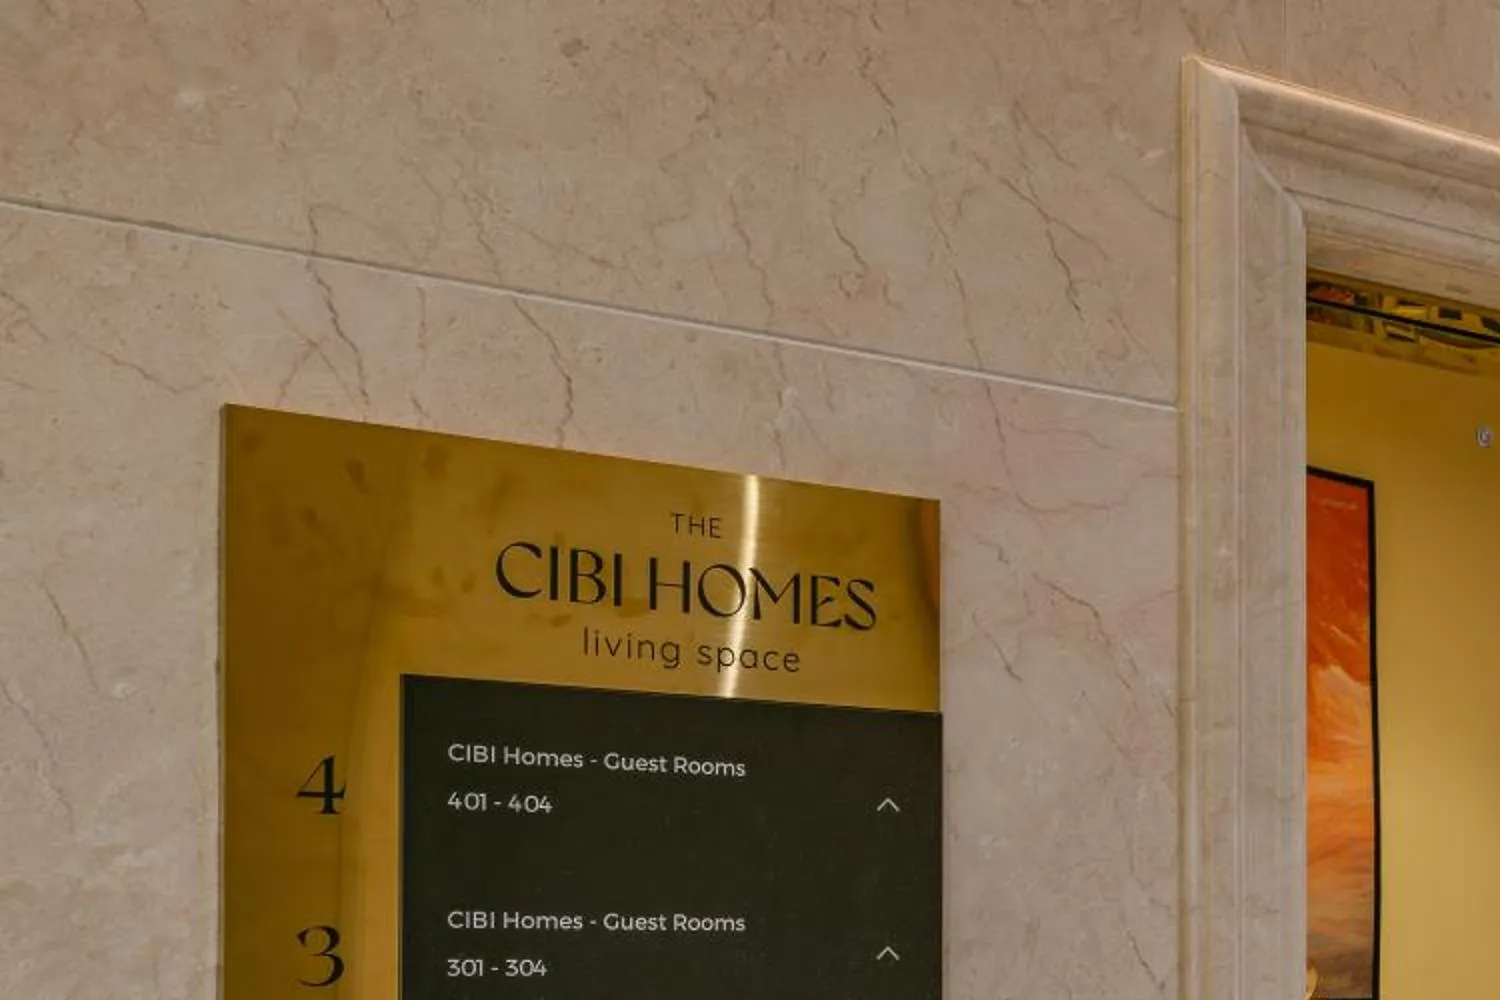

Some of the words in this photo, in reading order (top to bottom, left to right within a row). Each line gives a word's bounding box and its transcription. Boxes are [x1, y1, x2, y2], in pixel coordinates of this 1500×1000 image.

[670, 512, 721, 539] THE
[495, 541, 623, 608] CIBI
[648, 556, 877, 632] HOMES
[583, 626, 681, 670] living
[697, 644, 801, 673] space
[447, 743, 496, 764] CIBI
[503, 746, 584, 769] Homes
[603, 751, 668, 773] Guest
[673, 755, 746, 777] Rooms
[295, 755, 346, 815] 4
[447, 791, 487, 812] 401
[507, 794, 553, 814] 404
[447, 910, 495, 929] CIBI
[503, 911, 584, 931] Homes
[602, 912, 668, 932] Guest
[673, 913, 746, 932] Rooms
[296, 925, 345, 988] 3
[447, 958, 484, 977] 301
[504, 958, 548, 977] 304
